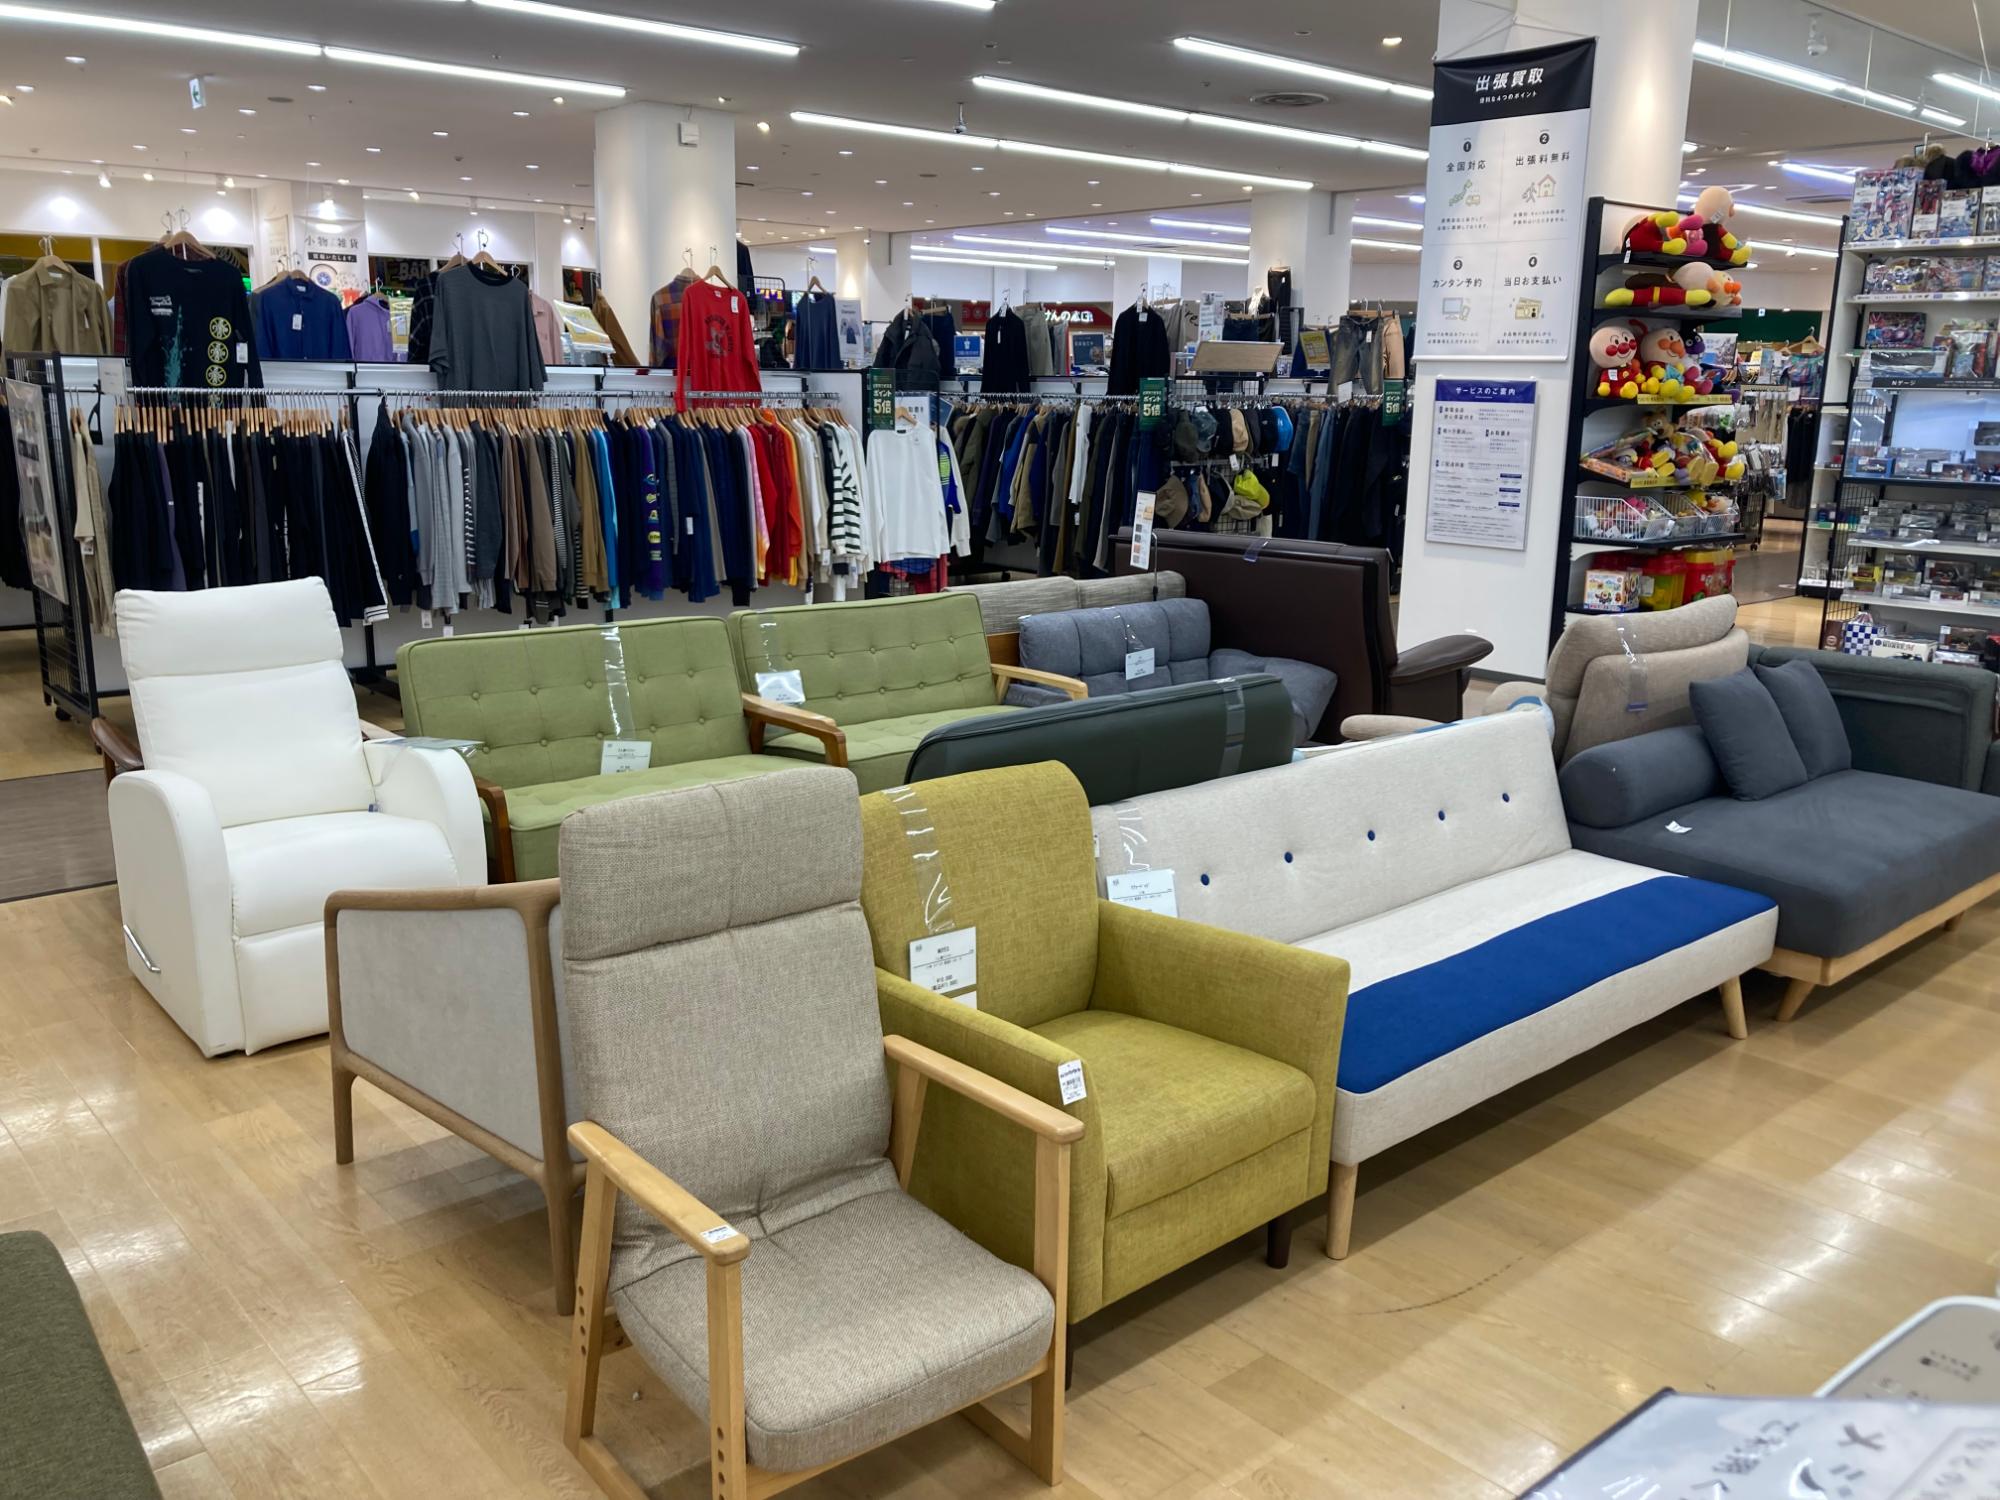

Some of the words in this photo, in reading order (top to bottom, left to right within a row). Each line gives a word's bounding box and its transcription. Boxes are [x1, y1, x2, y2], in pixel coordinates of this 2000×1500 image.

[1475, 67, 1544, 92] 出張買取
[1515, 151, 1571, 167] 出張料無料
[1446, 160, 1487, 173] 全国対応
[1432, 278, 1483, 288] カンタン予約
[1504, 276, 1562, 287] 当日お支払い
[873, 389, 892, 398] ポイント
[1455, 387, 1516, 396] サービスのご案内
[873, 399, 892, 414] 5倍
[1143, 403, 1161, 416] 5倍
